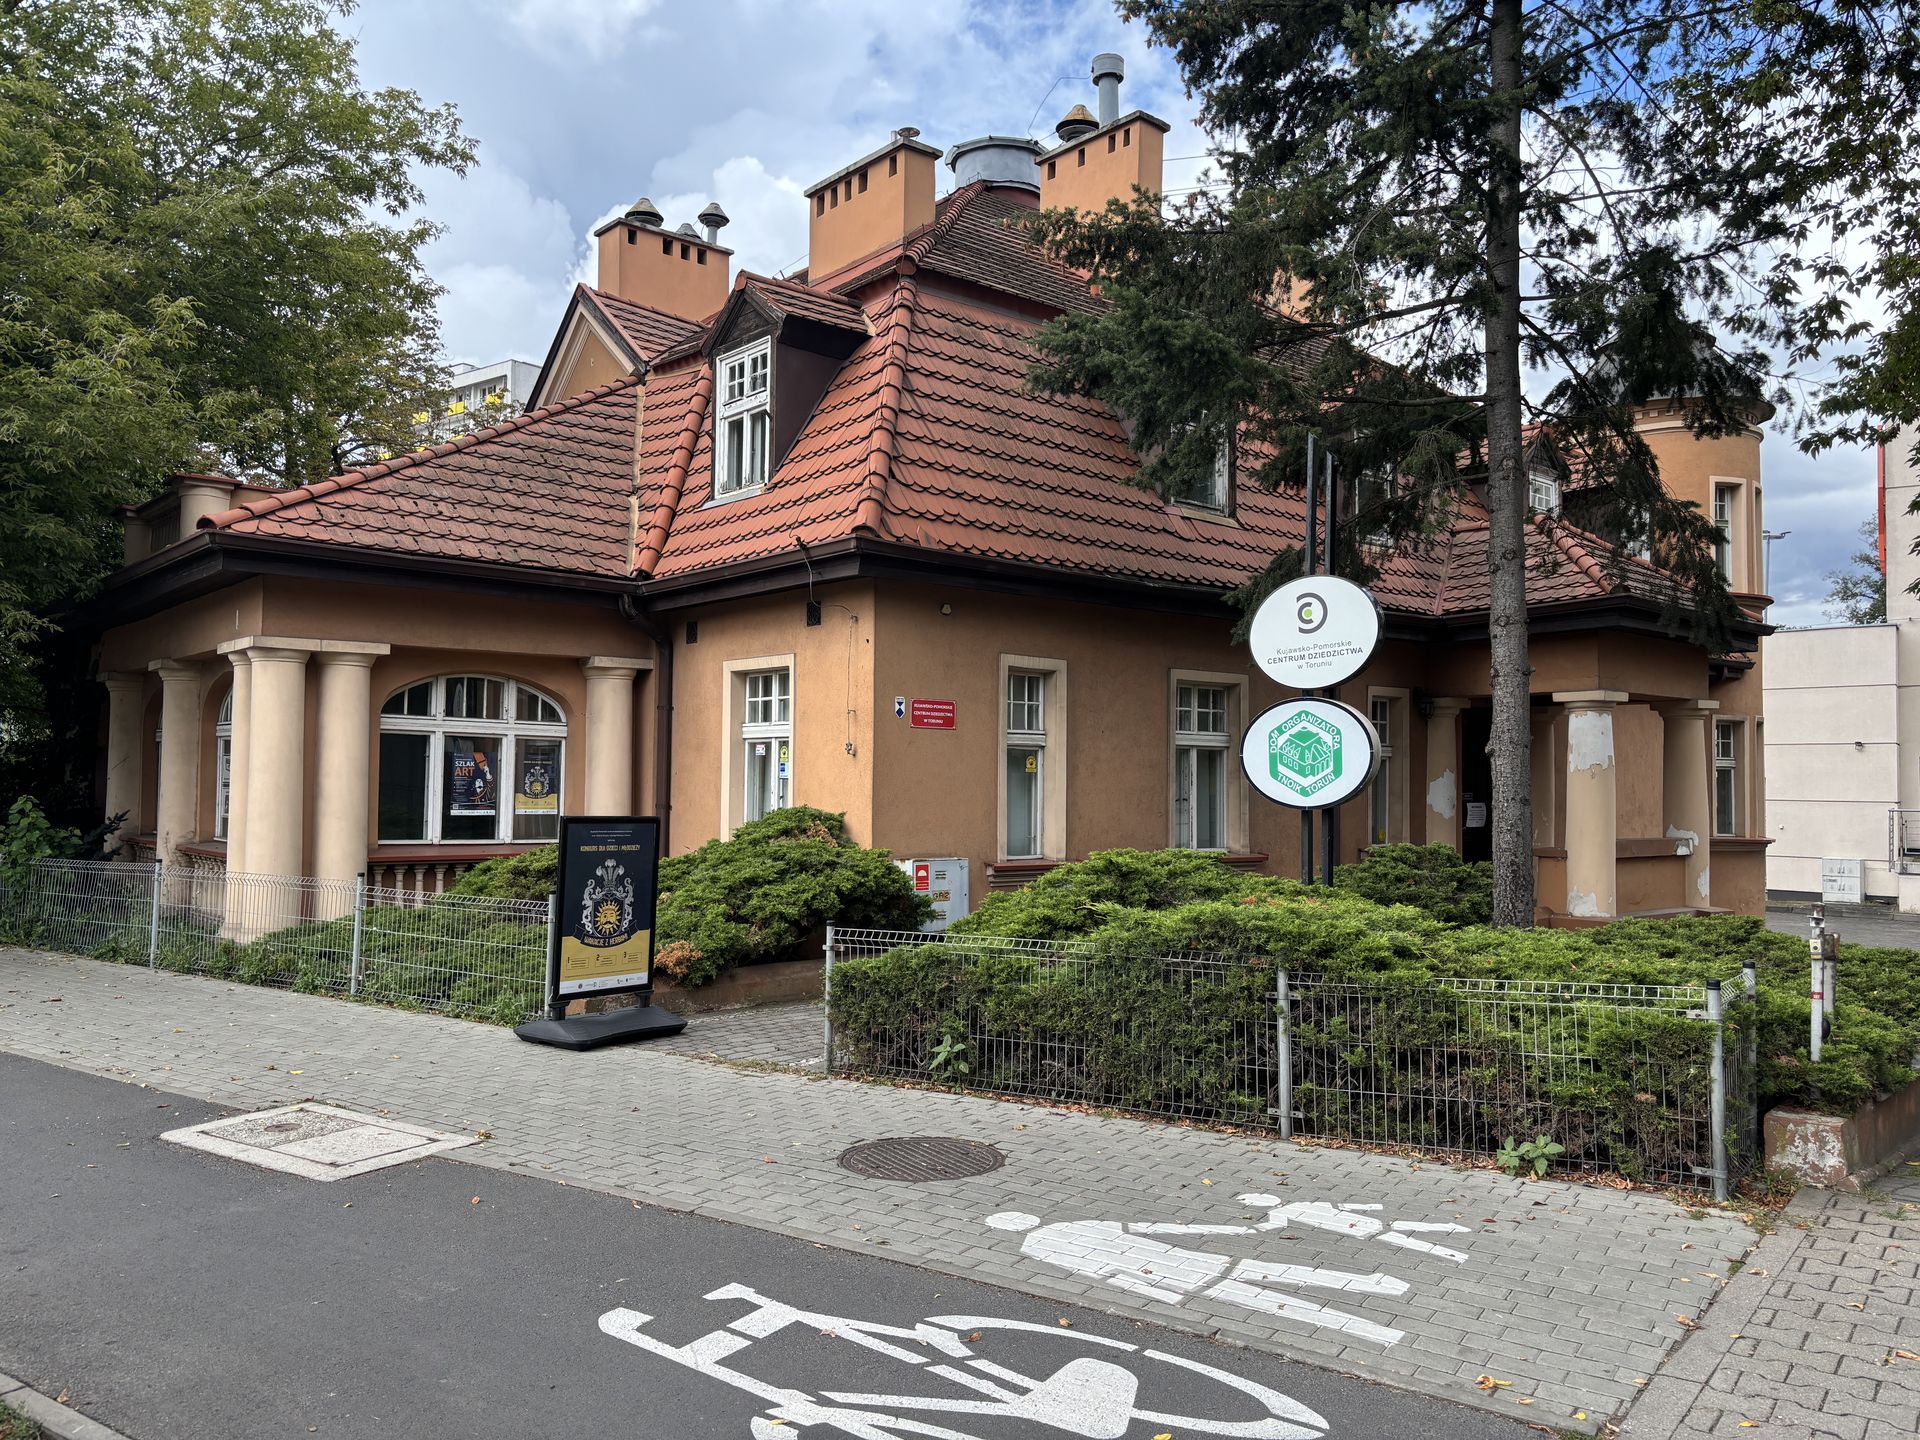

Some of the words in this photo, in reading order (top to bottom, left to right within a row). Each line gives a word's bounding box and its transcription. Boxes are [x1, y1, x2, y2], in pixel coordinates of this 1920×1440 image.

[1276, 640, 1352, 655] Kujawsko-Pomorskie
[1267, 653, 1306, 665] CENTRUM
[1307, 647, 1364, 660] DZIEDZICTWA
[1304, 660, 1332, 669] Toruniu
[1269, 729, 1280, 753] DOM
[1281, 712, 1341, 750] ORGANIZATORA
[454, 767, 475, 777] ART
[1277, 773, 1302, 794] TNOIK
